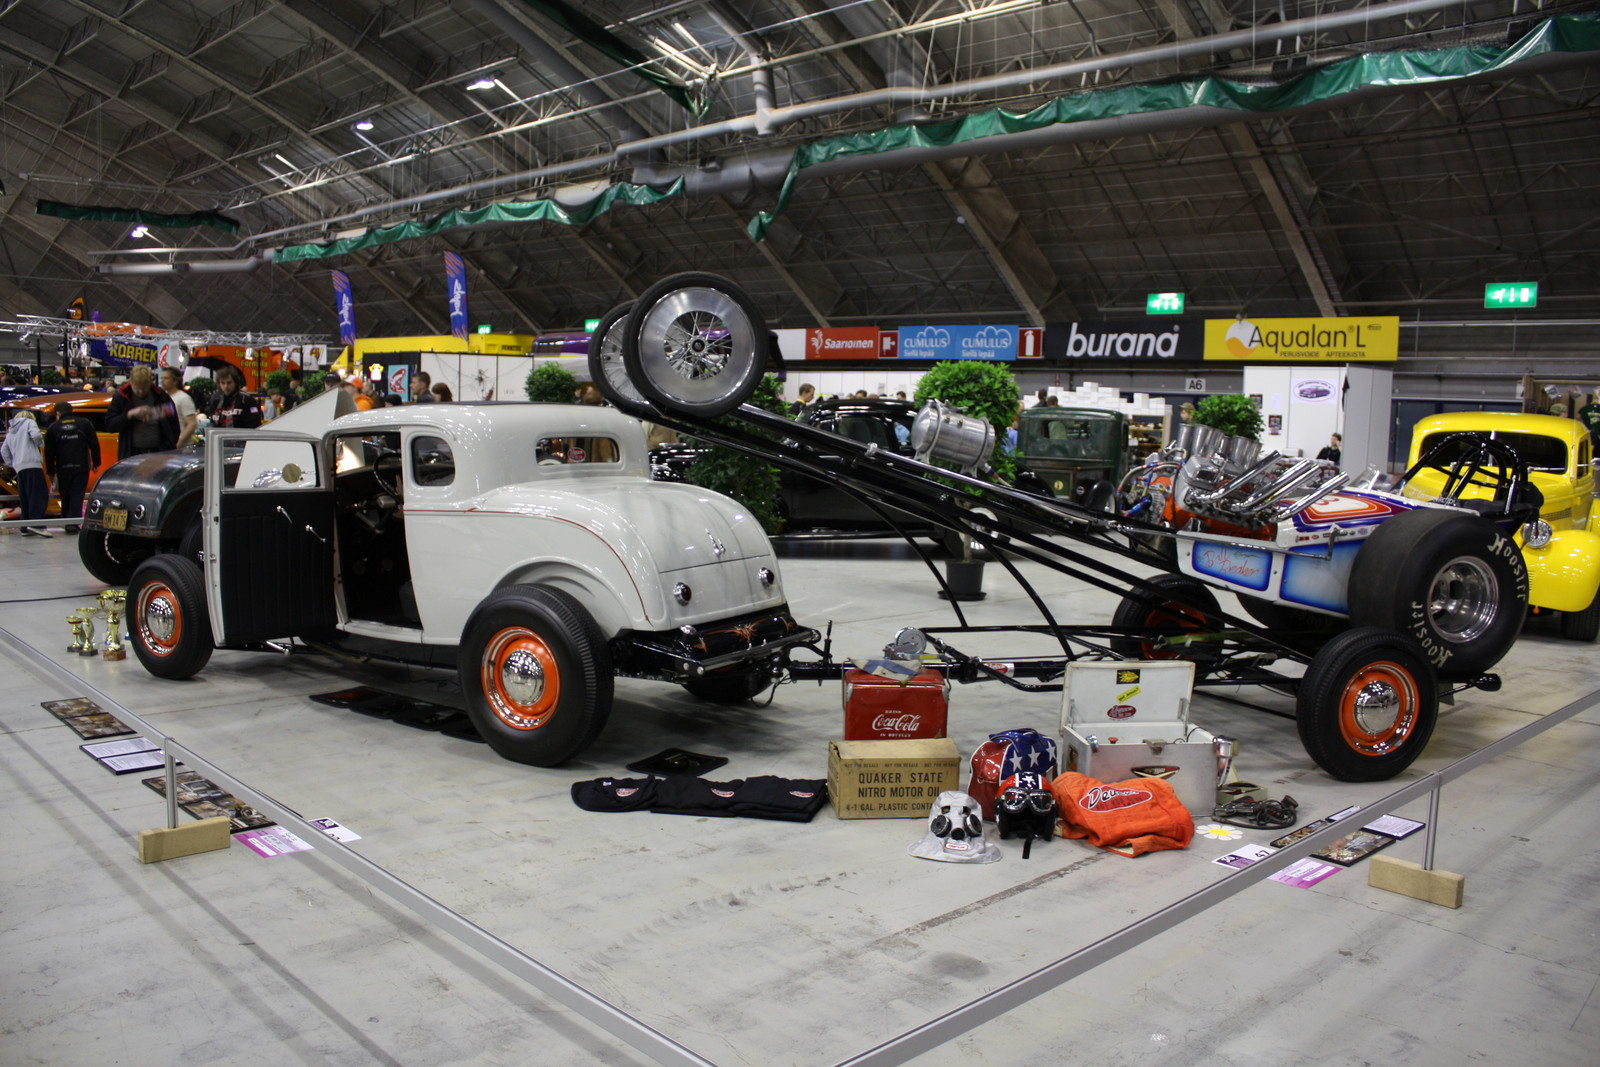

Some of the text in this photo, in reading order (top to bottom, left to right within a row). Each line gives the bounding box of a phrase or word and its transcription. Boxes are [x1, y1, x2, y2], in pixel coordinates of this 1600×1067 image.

[1066, 322, 1180, 357] burana
[1356, 325, 1366, 347] L
[824, 338, 874, 349] Saarioinen
[904, 337, 948, 348] CUMULUS
[962, 337, 1009, 348] CUMULUS
[1188, 380, 1203, 390] A6
[1486, 533, 1528, 601] Hoosier
[1412, 601, 1453, 668] Hoosier
[858, 772, 943, 783] QUAKER STATE
[858, 786, 940, 798] NITRO MOTOR OIL
[1254, 849, 1270, 858] 47
